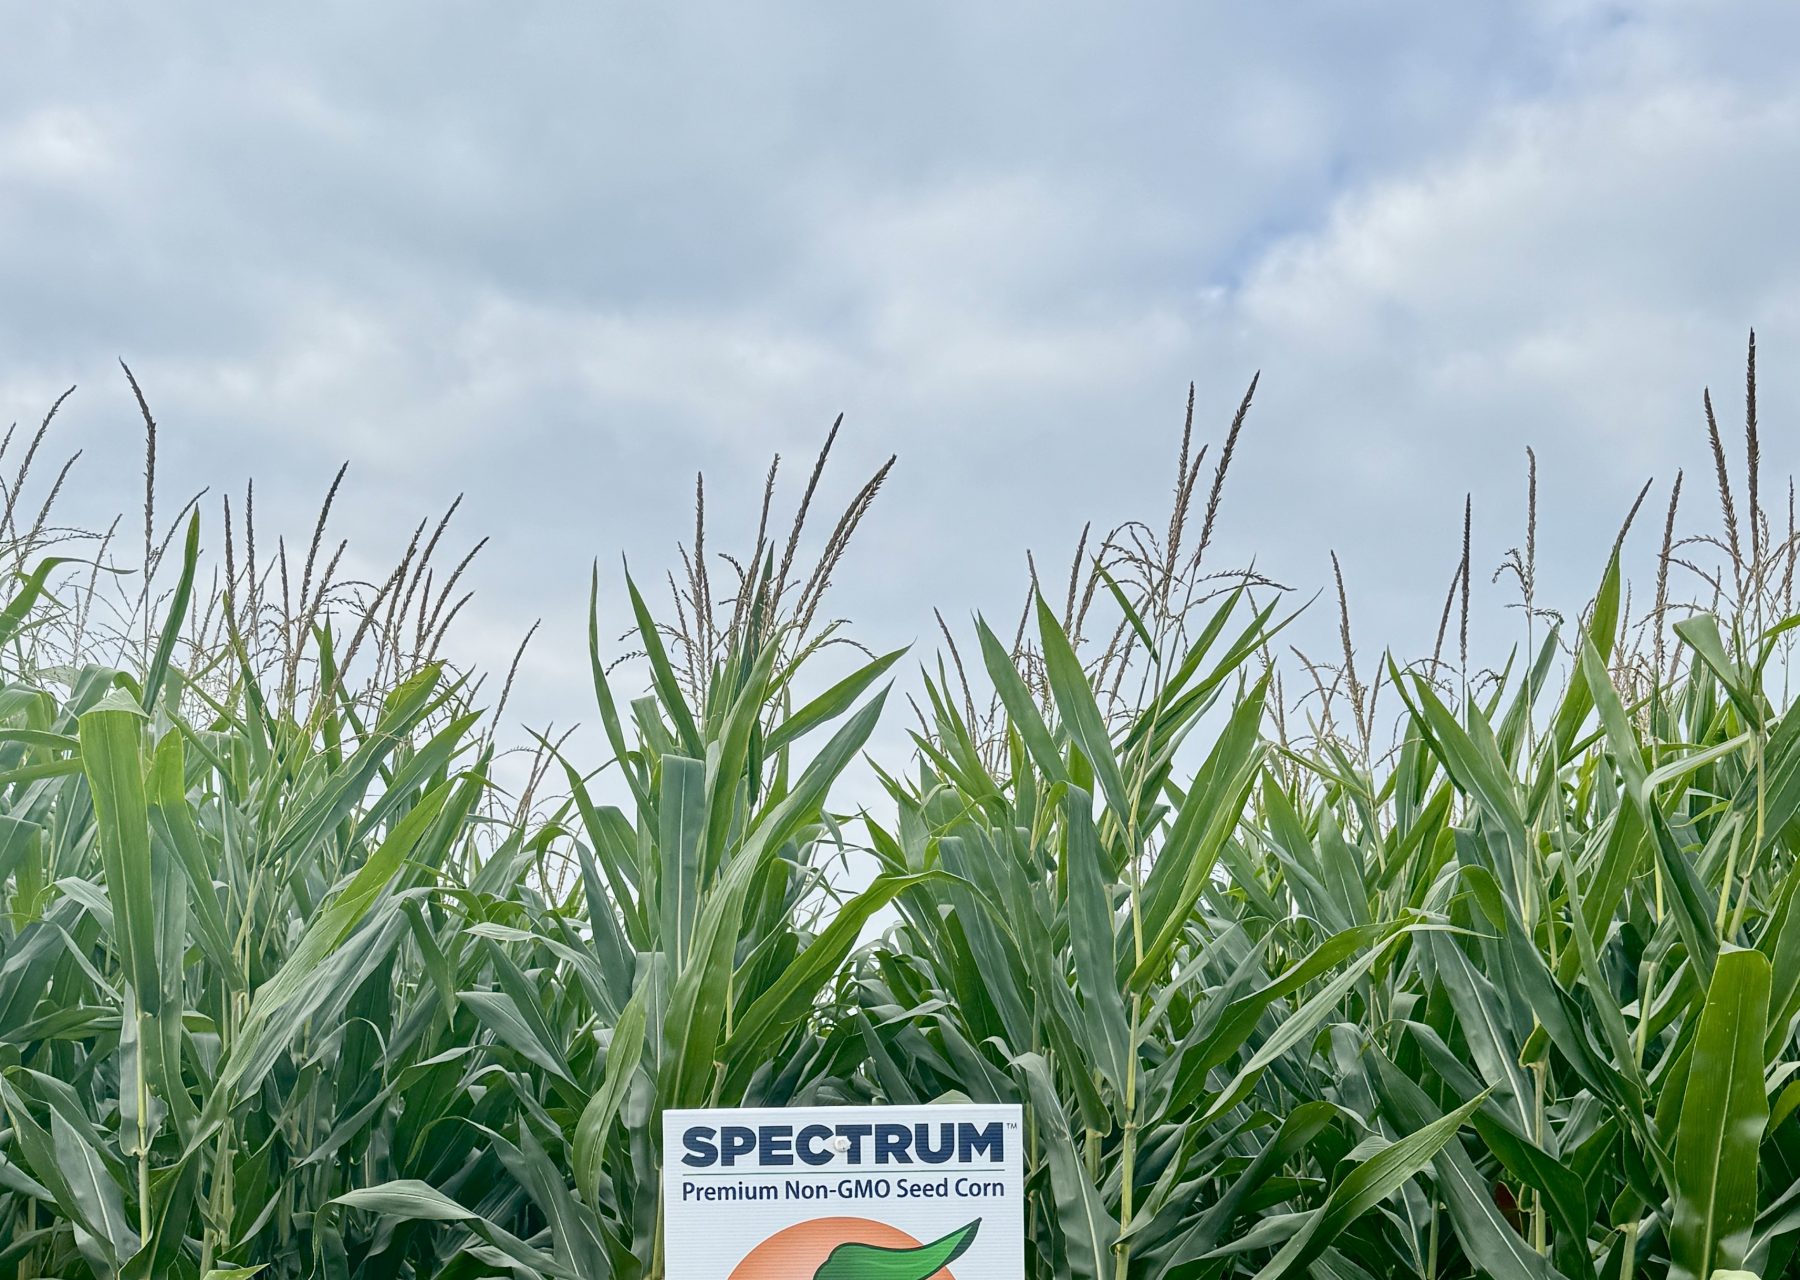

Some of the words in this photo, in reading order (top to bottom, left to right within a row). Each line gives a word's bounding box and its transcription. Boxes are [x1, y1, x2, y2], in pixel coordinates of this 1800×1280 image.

[681, 1122, 1004, 1167] SPECTRUM
[682, 1181, 778, 1201] Premium
[785, 1178, 891, 1200] Non-GMO
[897, 1177, 948, 1198] Seed
[954, 1178, 1005, 1197] Corn
